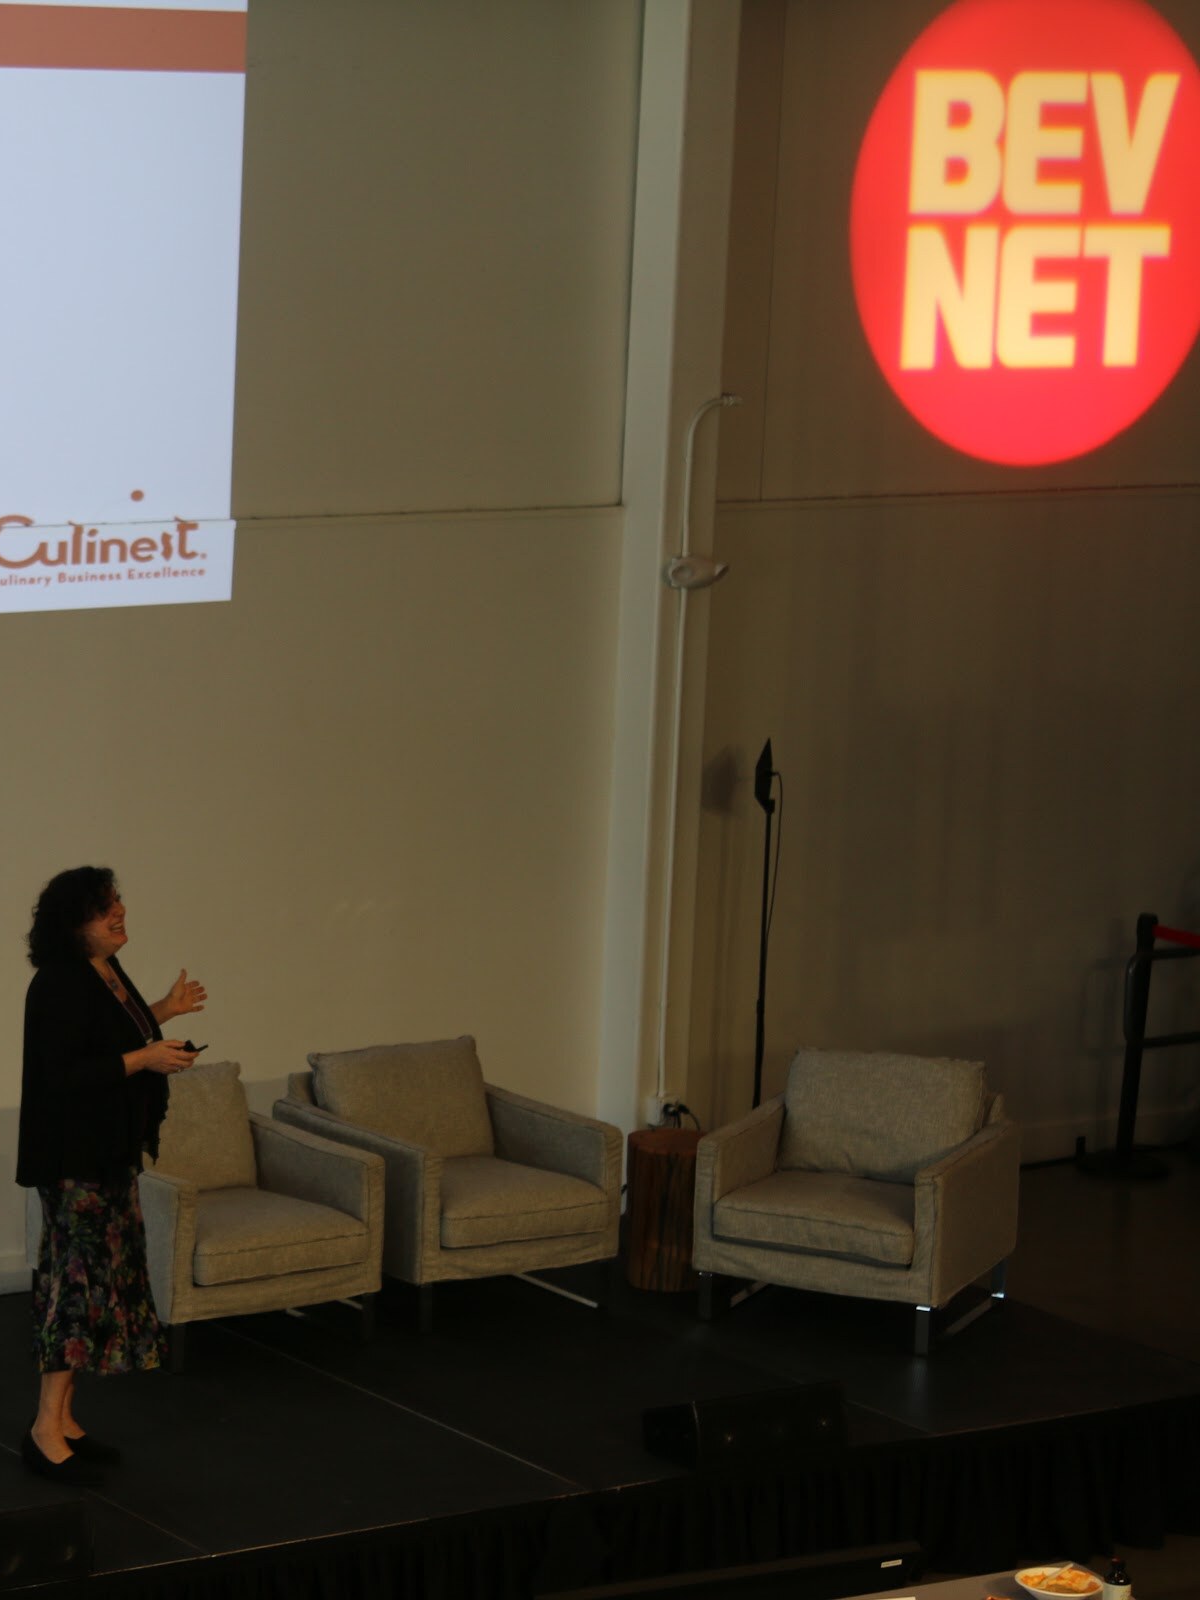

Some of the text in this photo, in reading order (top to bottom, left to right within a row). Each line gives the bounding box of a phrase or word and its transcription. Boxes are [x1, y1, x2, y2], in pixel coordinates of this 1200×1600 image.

[909, 69, 1181, 215] BEV
[901, 223, 1171, 370] NET
[58, 570, 122, 584] Business
[128, 566, 206, 580] Excellence
